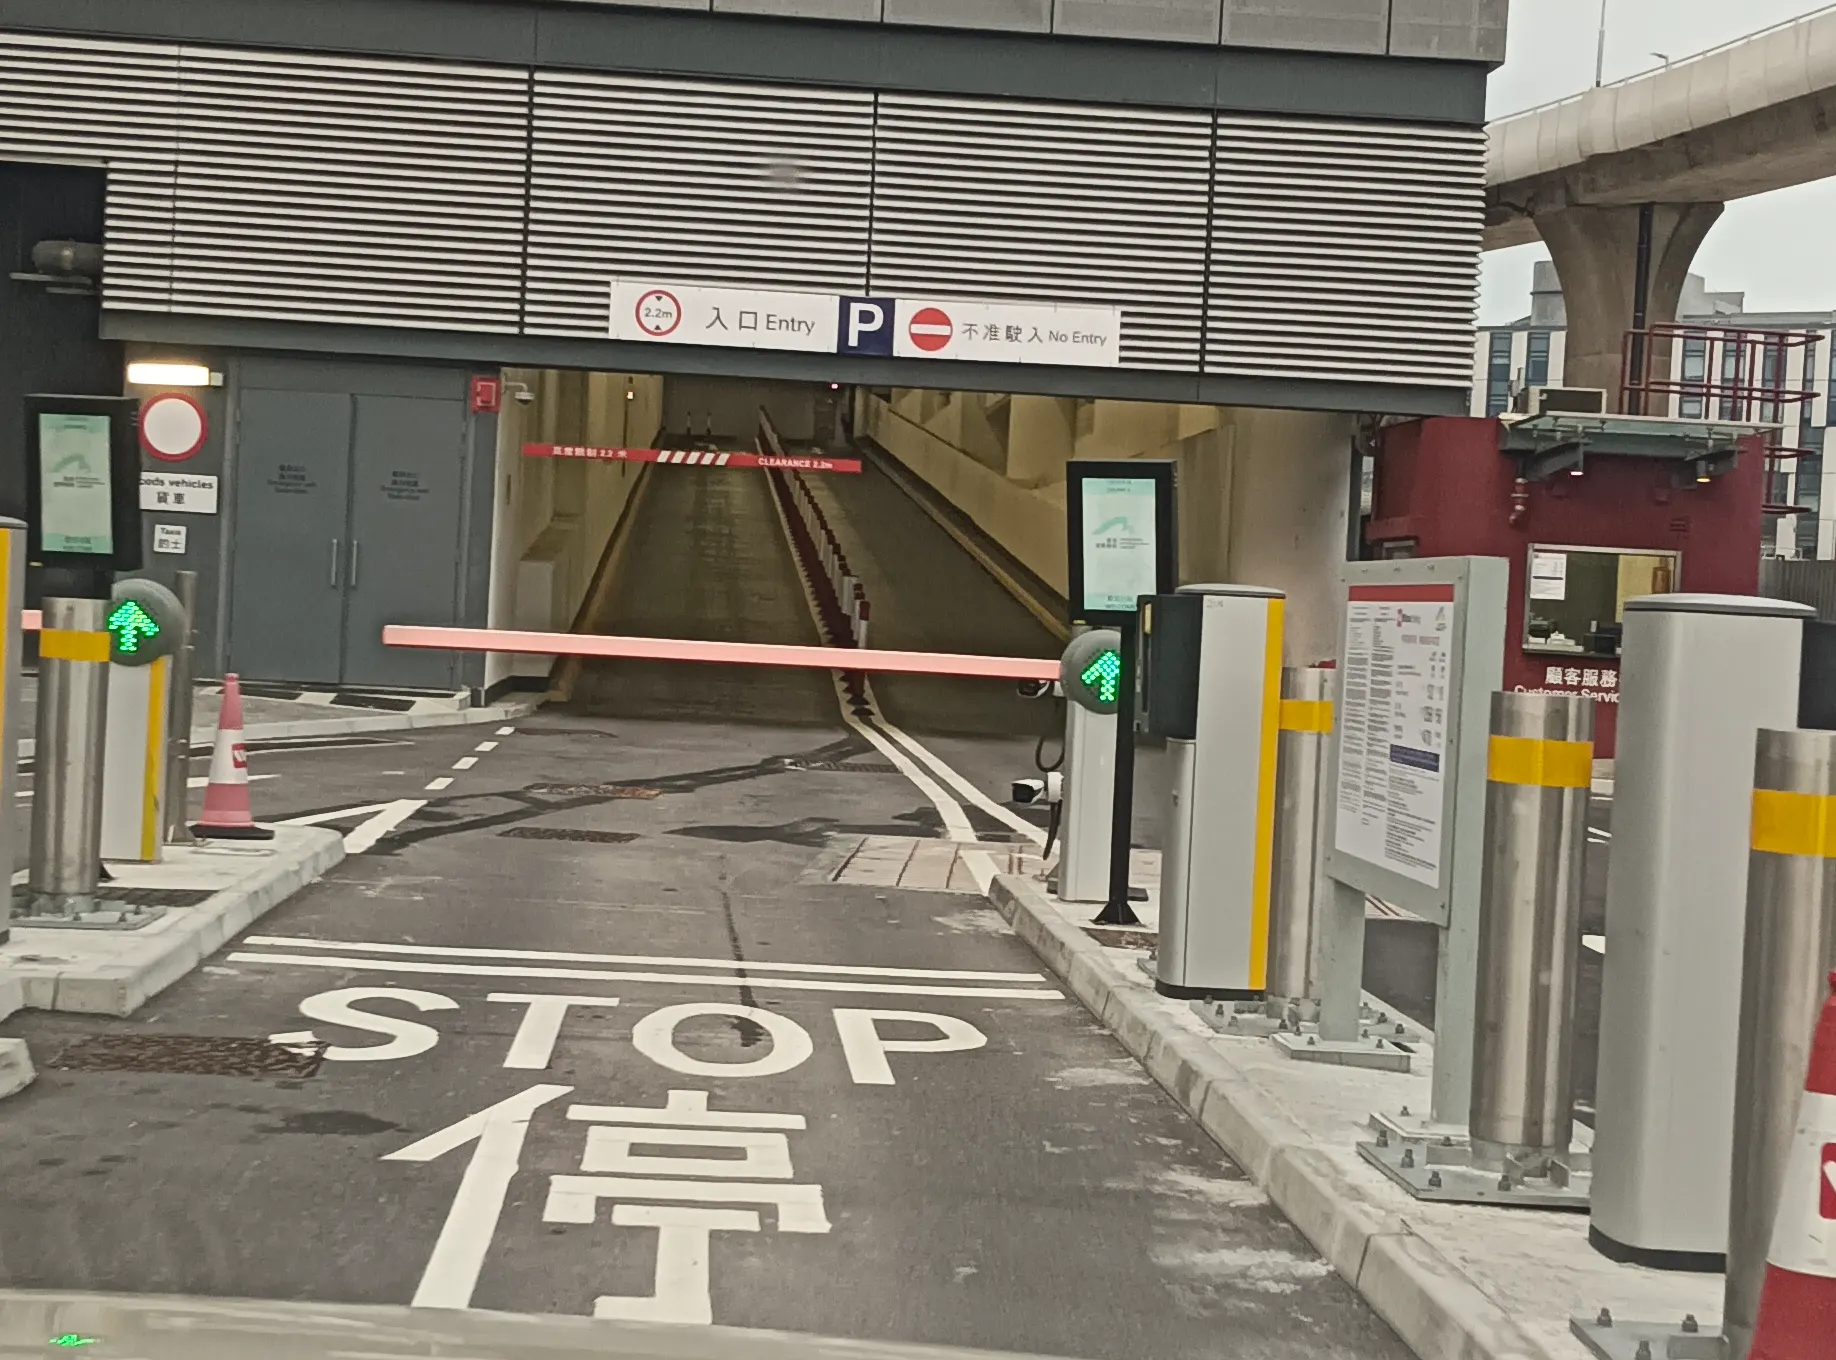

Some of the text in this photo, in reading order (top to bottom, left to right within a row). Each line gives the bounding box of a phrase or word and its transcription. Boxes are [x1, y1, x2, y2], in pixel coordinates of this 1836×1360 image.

[643, 307, 673, 319] 2.2m
[705, 306, 816, 336] 入口 Entry
[848, 302, 884, 347] P
[961, 323, 1108, 347] 不准駛入 No Entry
[758, 457, 811, 469] CLEARANCE
[139, 477, 214, 490] oods vehicles
[1545, 666, 1620, 688] 顧客服務
[270, 987, 988, 1085] STOP
[379, 1084, 833, 1325] 停
